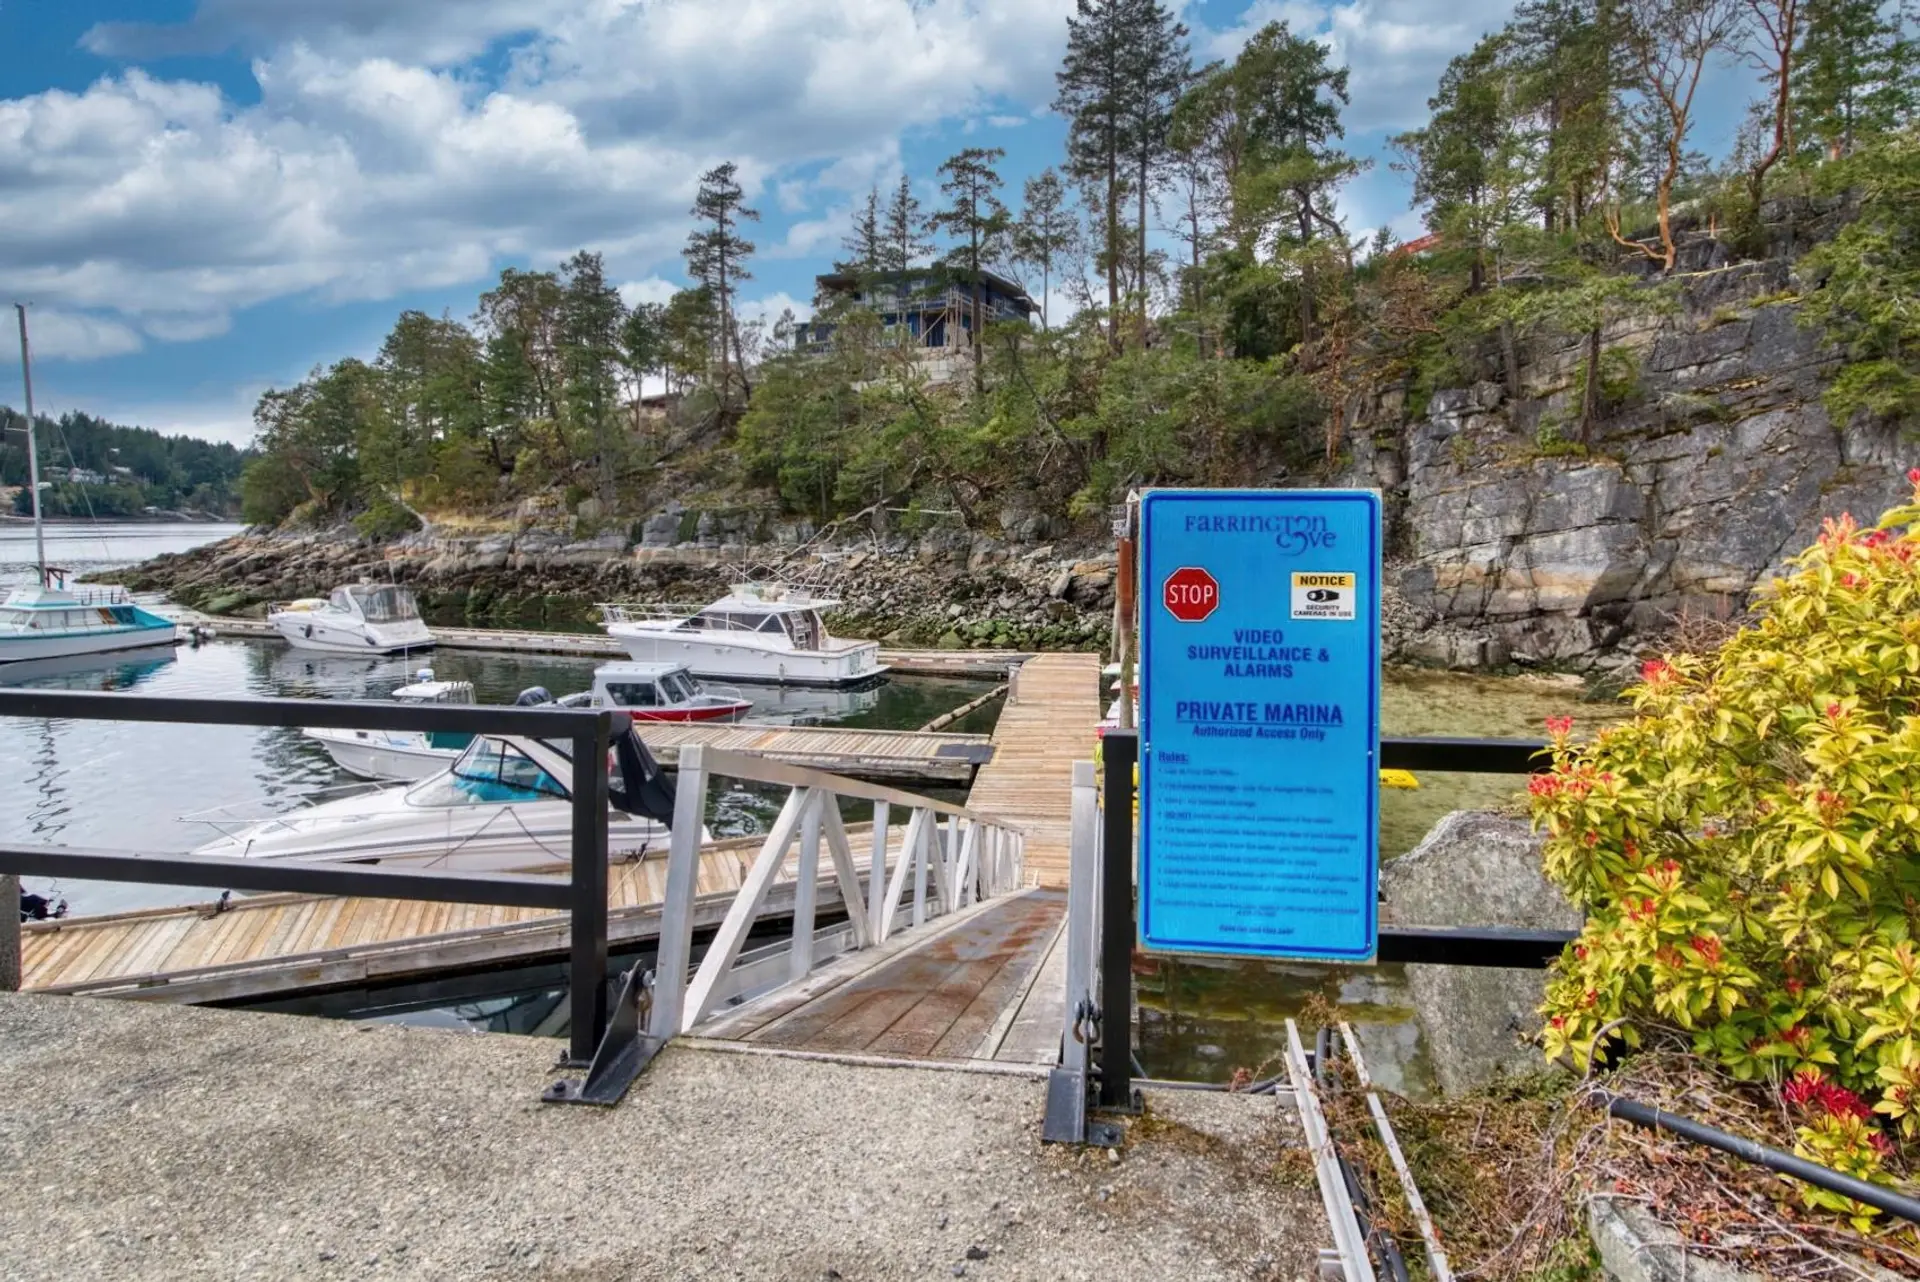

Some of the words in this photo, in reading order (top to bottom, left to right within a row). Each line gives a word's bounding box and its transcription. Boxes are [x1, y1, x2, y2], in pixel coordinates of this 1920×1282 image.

[1300, 575, 1346, 586] NOTICE
[1169, 584, 1214, 605] STOP
[1234, 629, 1284, 645] VIDEO
[1188, 645, 1313, 662] SURVEILLANCE
[1317, 648, 1330, 662] &
[1224, 663, 1294, 678] ALARMS
[1176, 701, 1258, 721] PRIVATE
[1264, 703, 1343, 724] MARINA
[1192, 725, 1252, 738] Authorized
[1256, 727, 1296, 739] Access
[1299, 728, 1326, 741] Only
